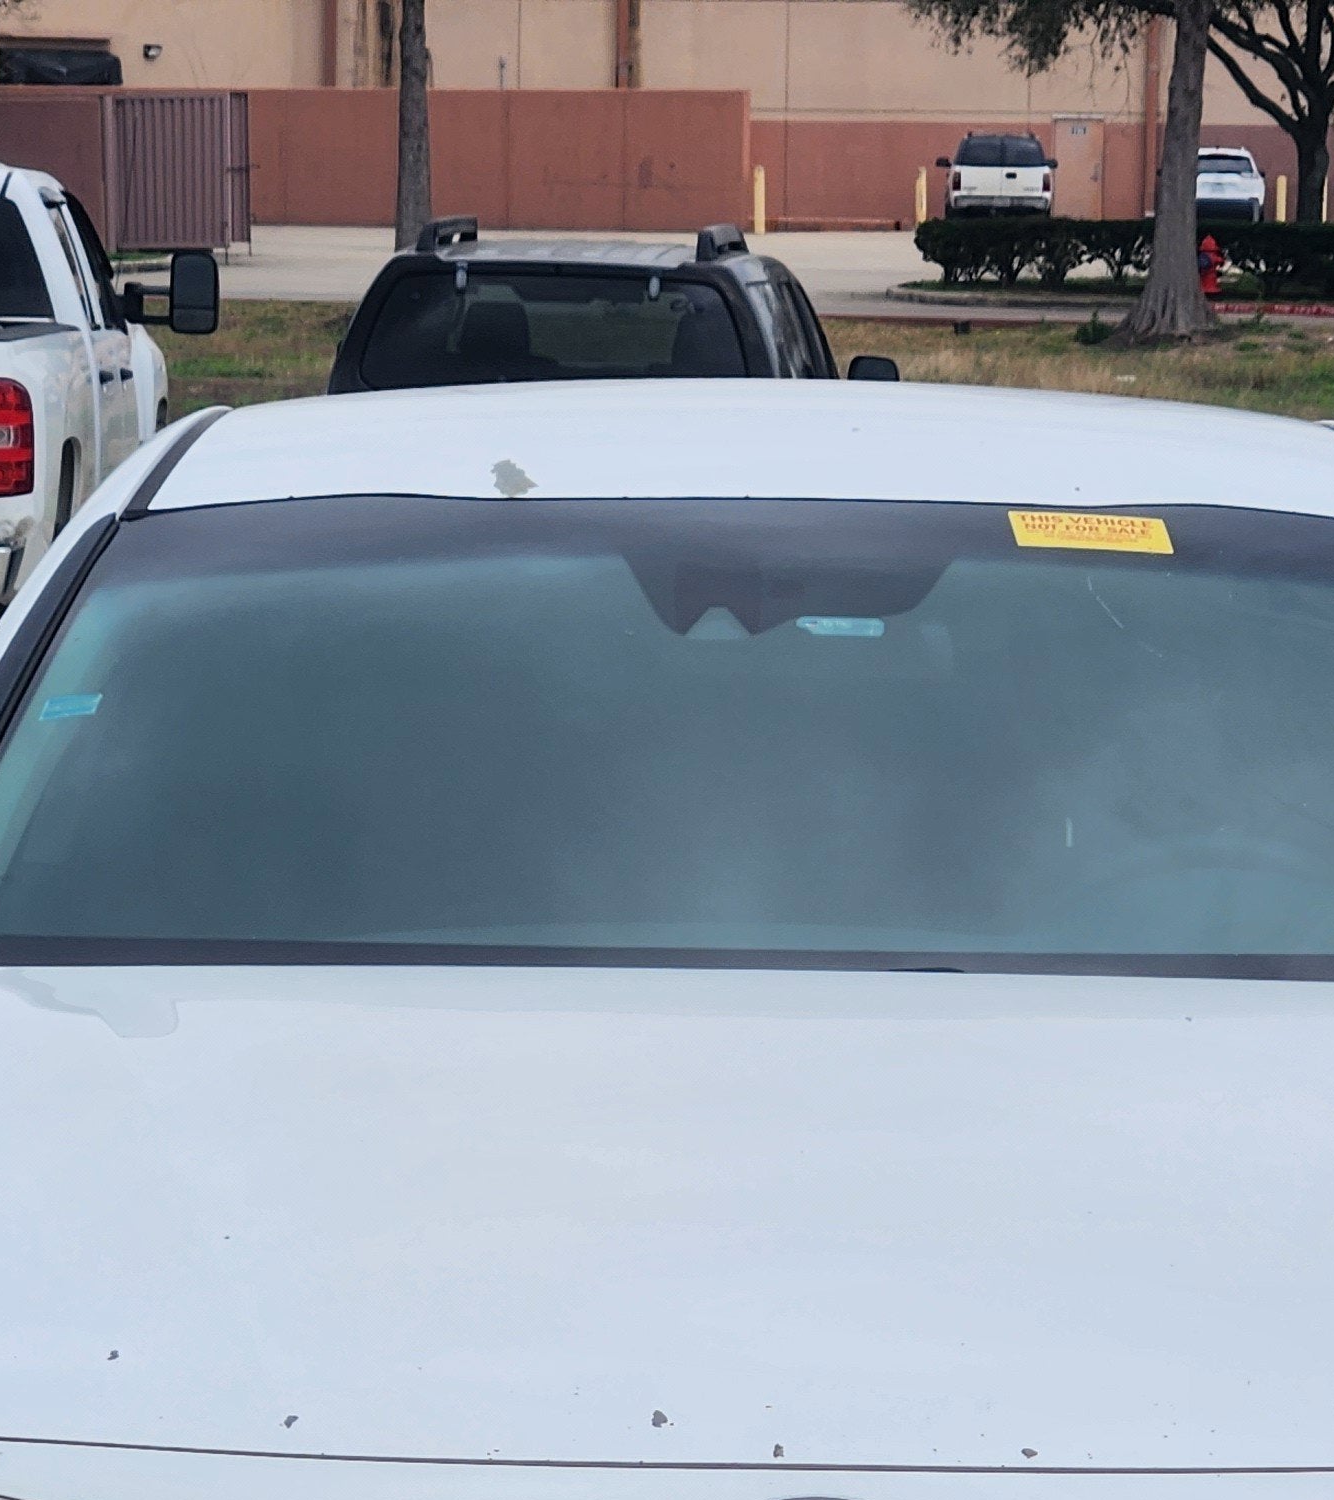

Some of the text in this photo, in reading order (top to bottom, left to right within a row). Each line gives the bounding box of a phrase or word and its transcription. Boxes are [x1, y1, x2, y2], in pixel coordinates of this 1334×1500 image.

[1018, 514, 1154, 529] THIS VEHICLE
[1024, 523, 1150, 536] NOT FOR SALE
